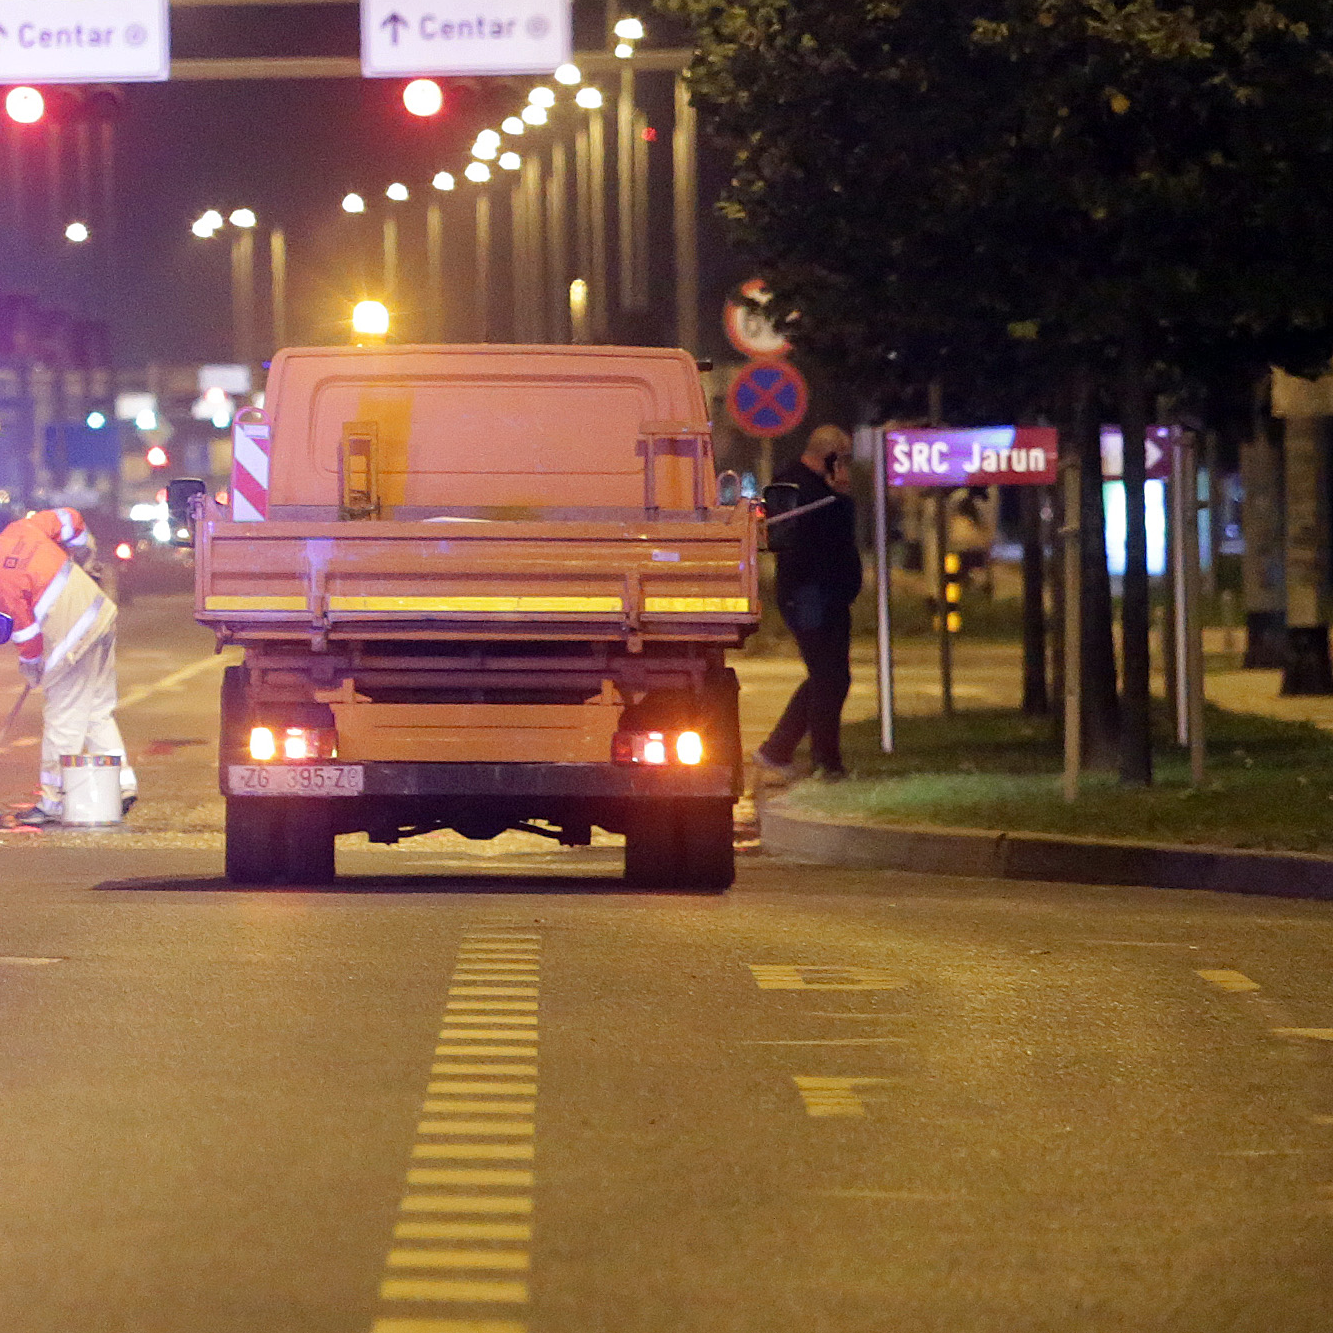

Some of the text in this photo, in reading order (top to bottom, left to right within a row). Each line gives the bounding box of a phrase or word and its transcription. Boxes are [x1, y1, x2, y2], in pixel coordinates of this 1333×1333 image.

[19, 21, 113, 49] Centar
[420, 13, 515, 40] Centar
[893, 434, 1046, 475] ŠRC Jarun
[244, 768, 269, 788] ZG
